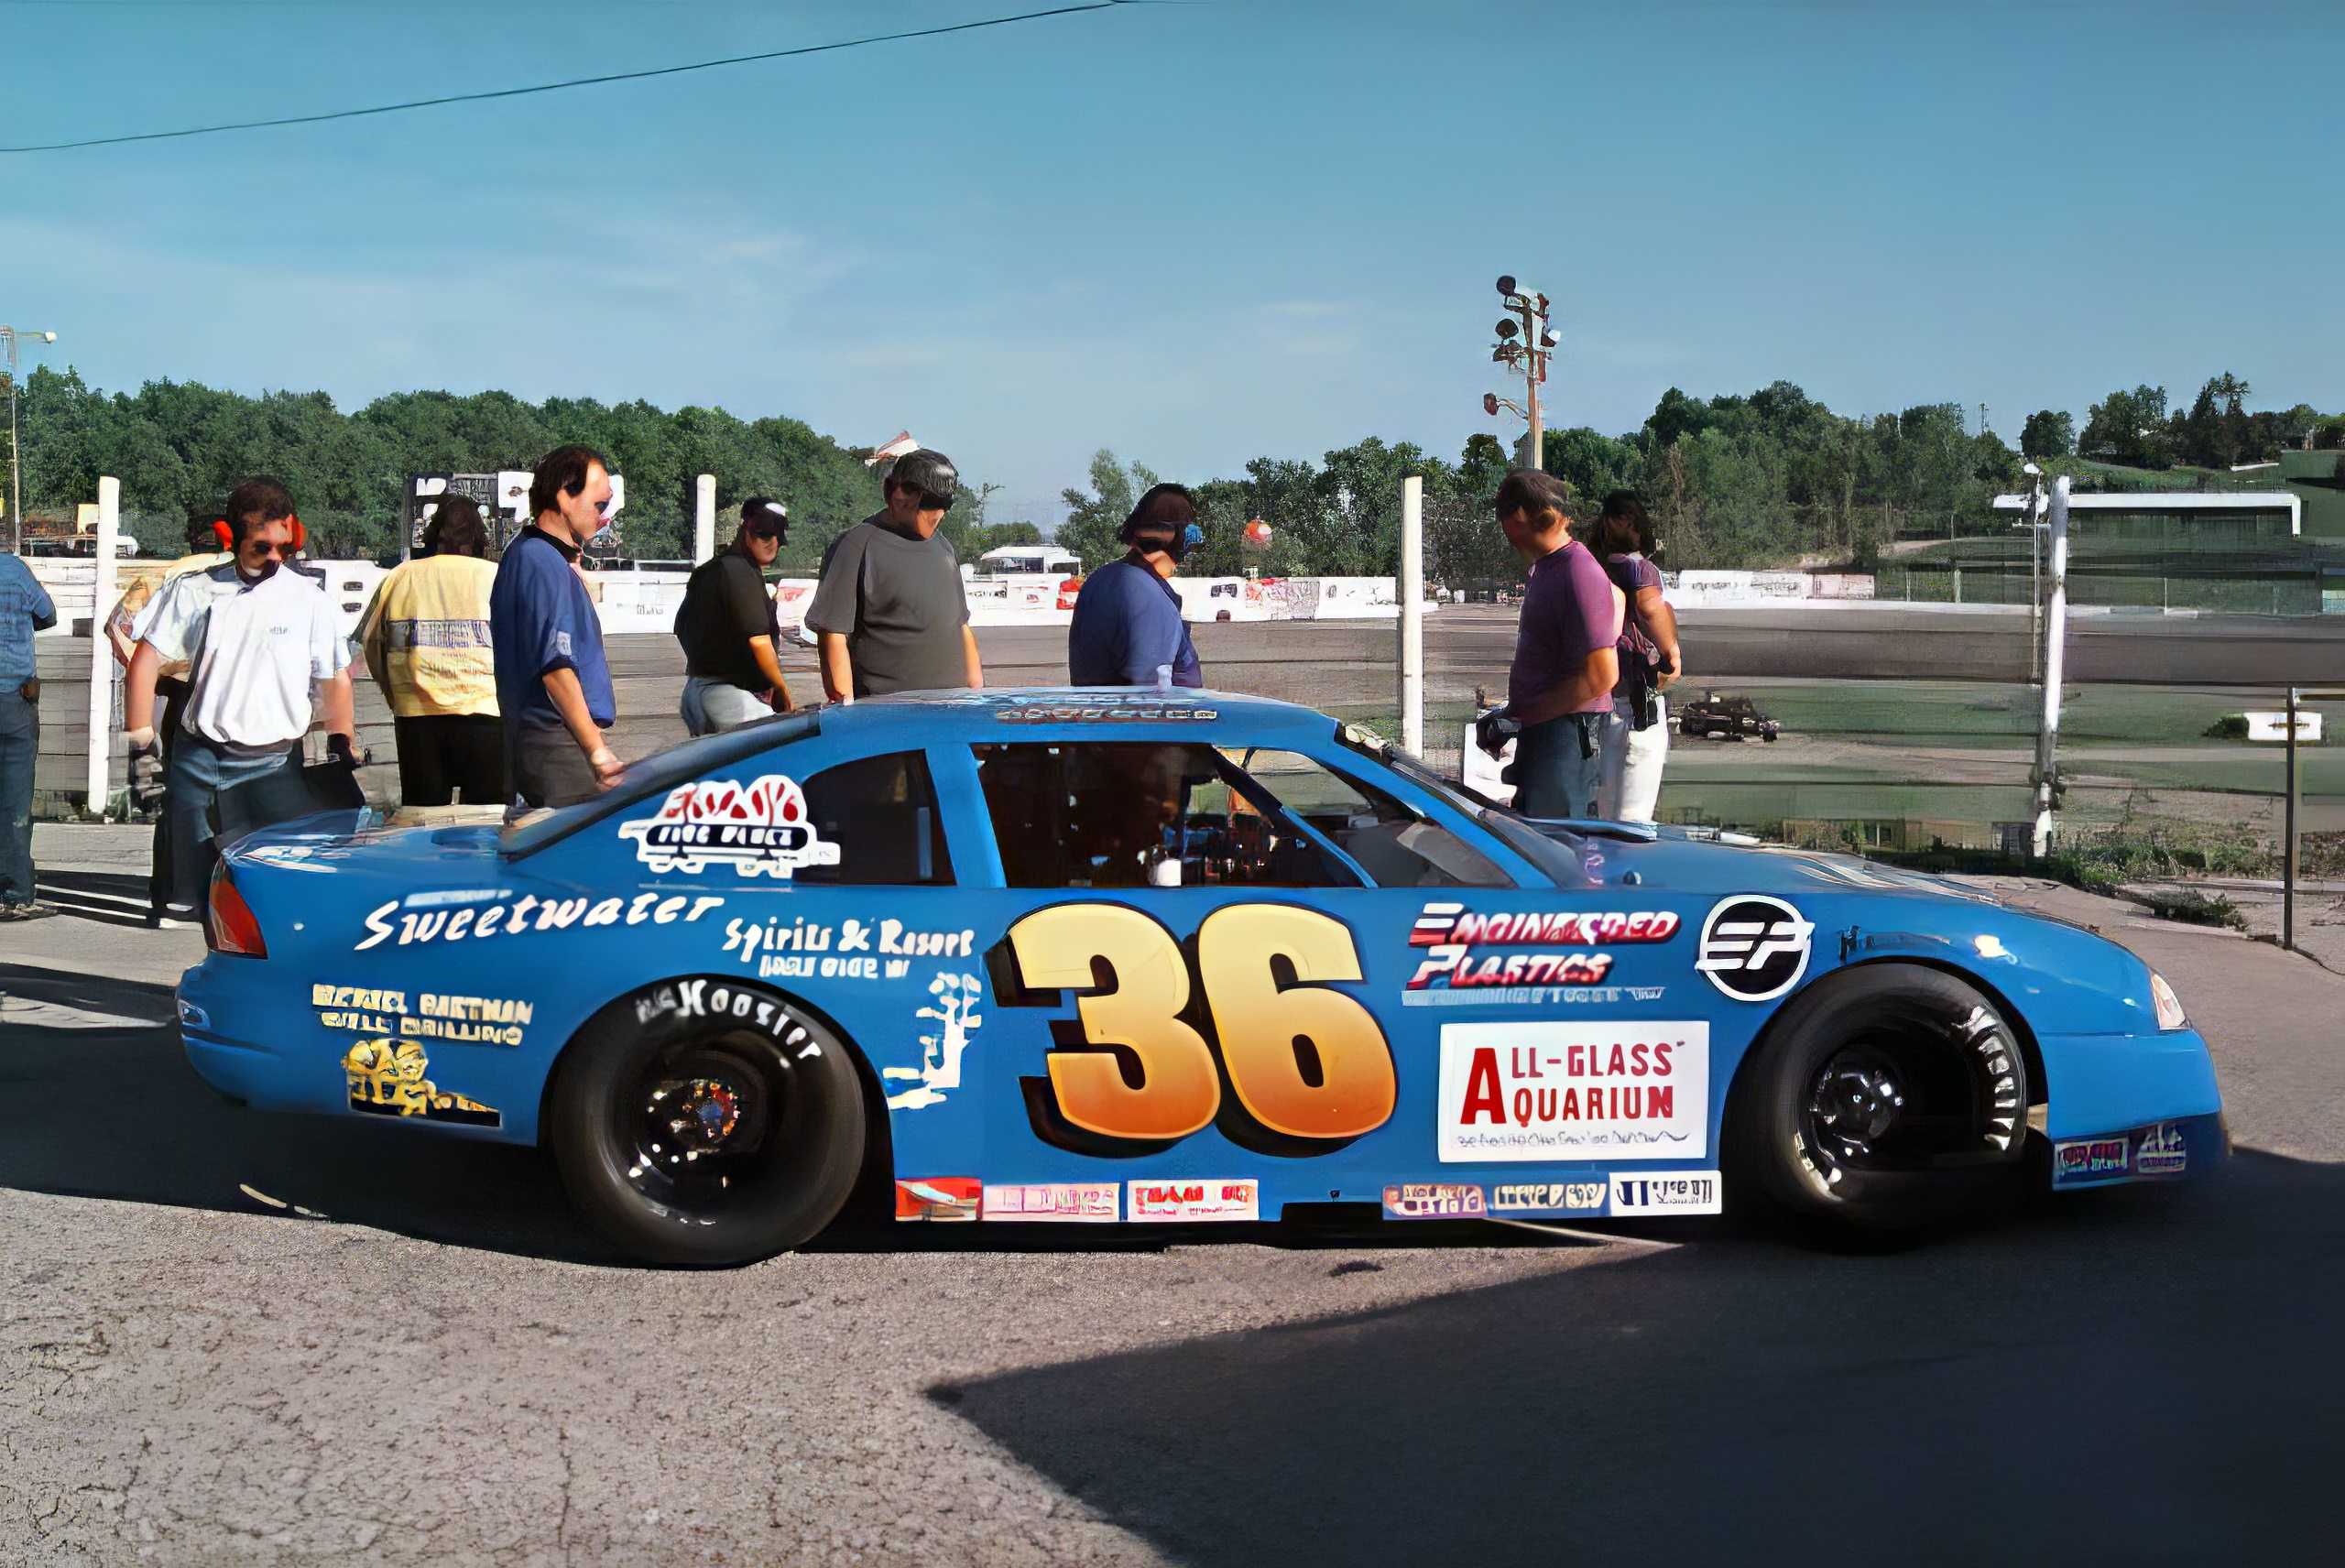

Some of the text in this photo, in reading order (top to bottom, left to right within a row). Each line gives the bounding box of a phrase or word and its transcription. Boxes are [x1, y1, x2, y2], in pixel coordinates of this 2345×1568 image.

[354, 892, 725, 951] Sweetwater
[837, 919, 871, 952] &
[1405, 943, 1614, 990] PLASTICS
[1008, 902, 1398, 1139] 36
